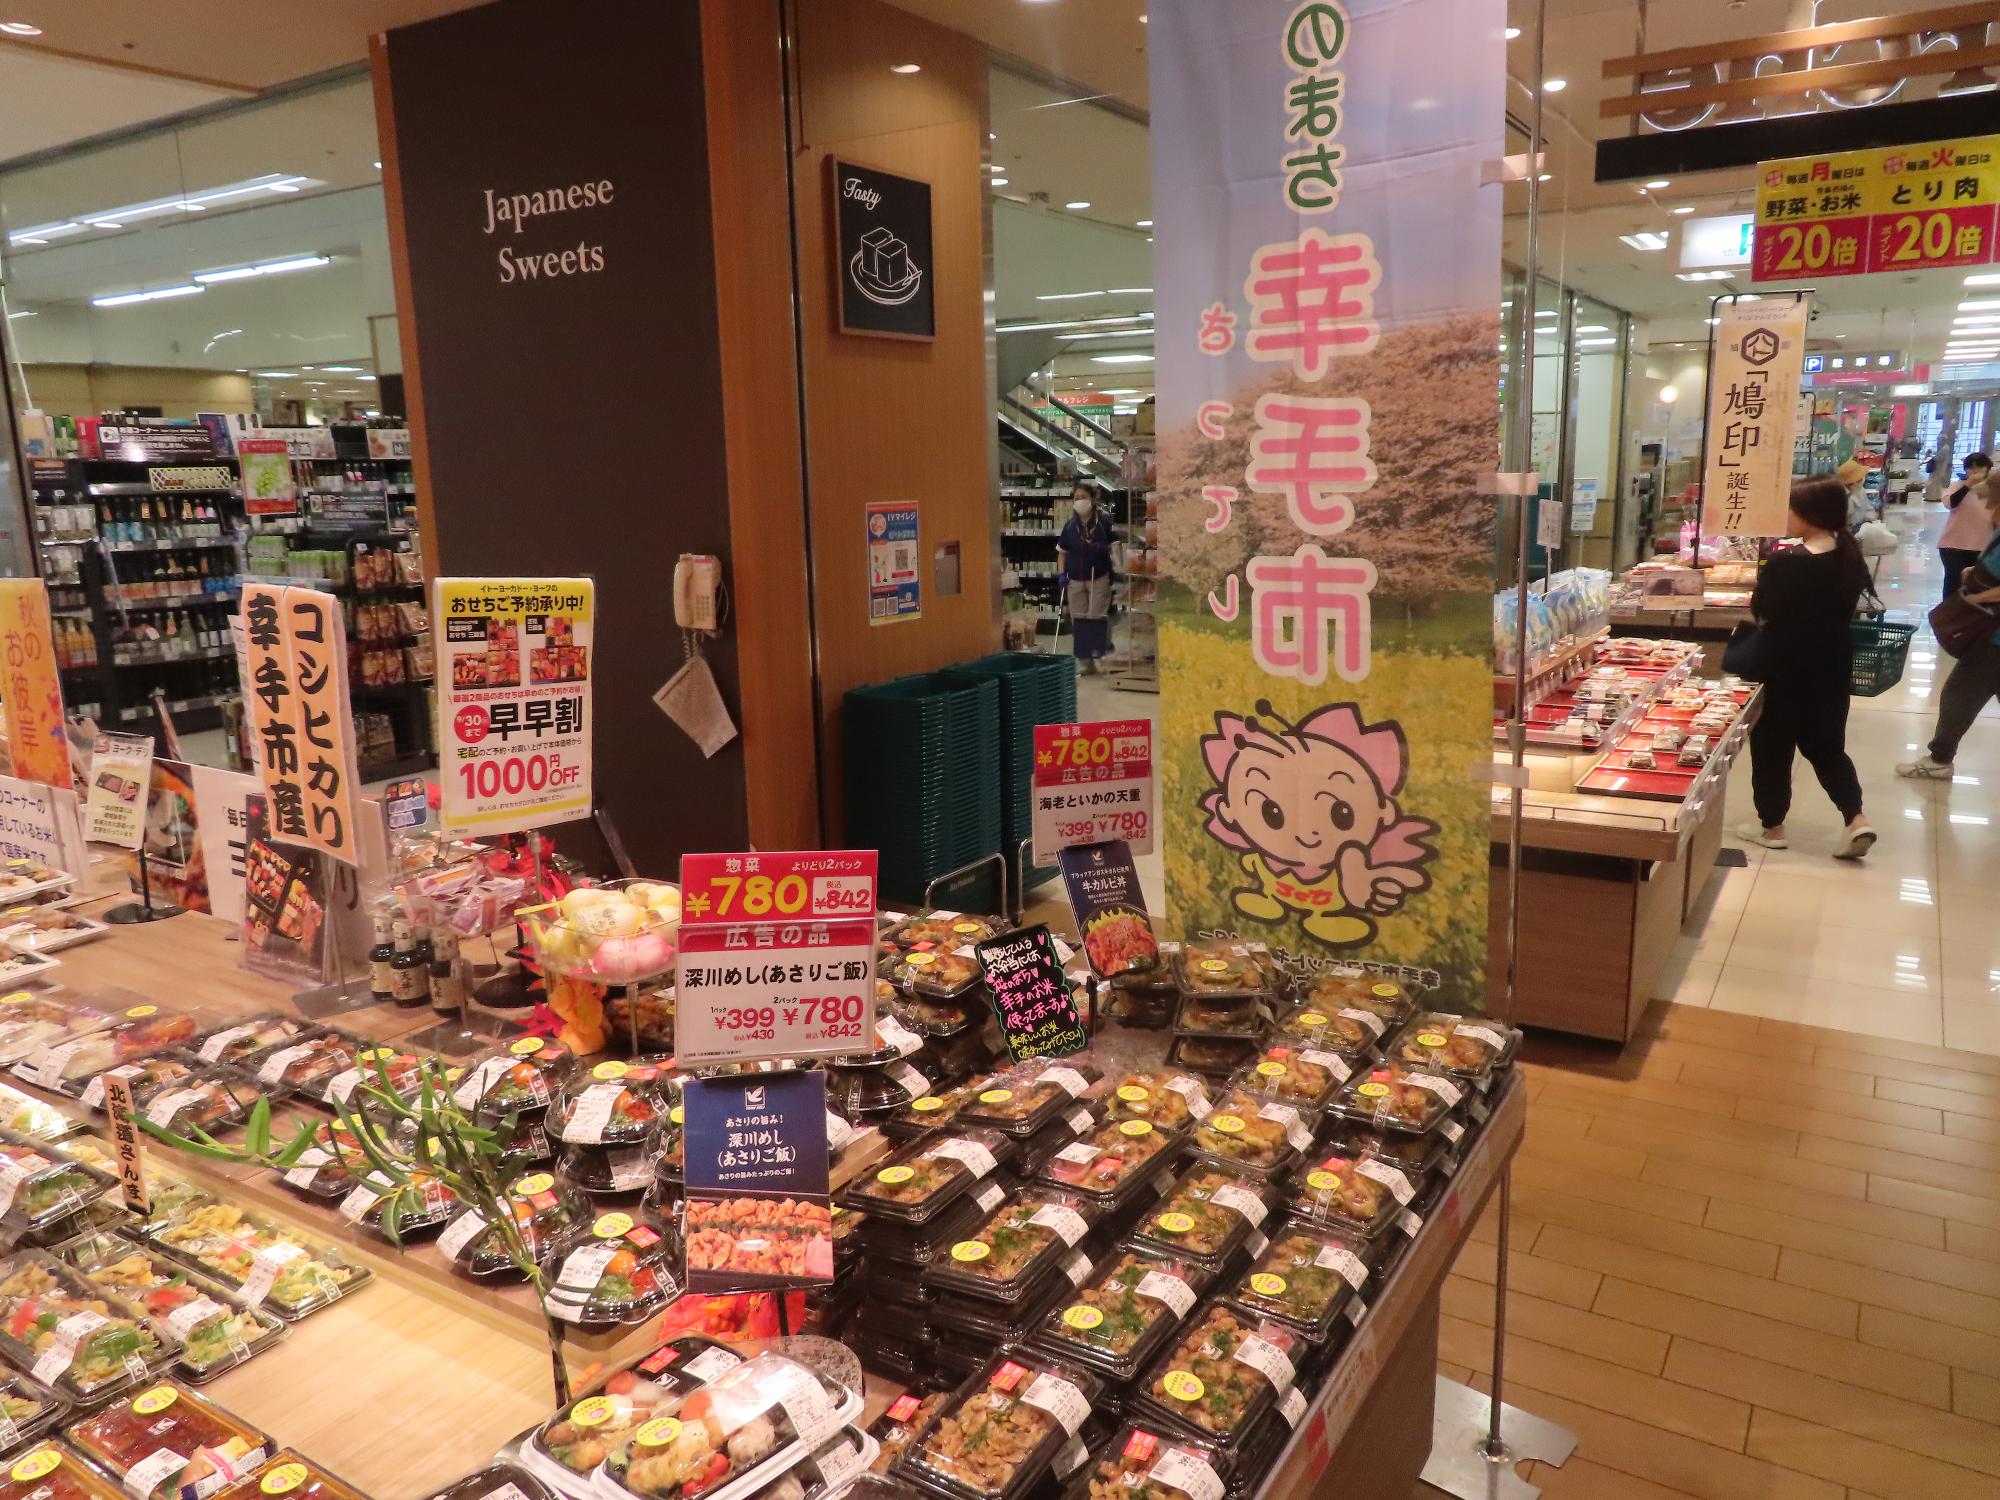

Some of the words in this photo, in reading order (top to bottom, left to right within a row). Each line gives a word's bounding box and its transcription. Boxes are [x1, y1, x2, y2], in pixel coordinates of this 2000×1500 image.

[843, 178, 881, 210] Tasty
[1892, 176, 1979, 204] とり肉
[483, 179, 614, 234] Japanese
[1766, 193, 1862, 218] 野菜・お米
[1776, 224, 1858, 271] 20倍
[1881, 224, 1892, 263] ポイント
[1892, 213, 1983, 261] 20倍
[499, 240, 605, 283] Sweets
[1763, 236, 1776, 273] ポイント
[481, 585, 557, 593] イトーヨーカドー・ヨークの
[451, 596, 584, 613] おせちご予約承り中!
[247, 592, 308, 838] 幸手市産
[294, 603, 344, 848] コシヒカリ
[488, 696, 583, 741] 早早割
[465, 728, 481, 737] まで
[1039, 788, 1141, 811] 海老といかの天重
[1057, 820, 1094, 838] ¥399
[1099, 810, 1148, 833] ¥780
[725, 857, 760, 873] 惣菜
[791, 858, 863, 872] よりどり2パック
[686, 874, 808, 917] ¥780
[827, 880, 841, 889] 税込
[1082, 876, 1126, 892] 牛カルビ丼
[815, 889, 870, 910] ¥842
[724, 923, 830, 948] 広告の品
[685, 961, 868, 988] 深川めし(あさりご飯)
[988, 949, 1041, 977] お弁当には
[773, 996, 798, 1004] 2パック
[1000, 978, 1058, 1011] 幸手のお米
[714, 1007, 775, 1030] ¥399
[783, 996, 864, 1025] ¥780
[820, 1023, 861, 1039] ¥842
[725, 1114, 783, 1128] あさりの旨み!
[110, 1084, 143, 1201] 北海道さんま
[728, 1129, 783, 1147] 深川めし
[717, 1146, 796, 1167] (あさりご飯)
